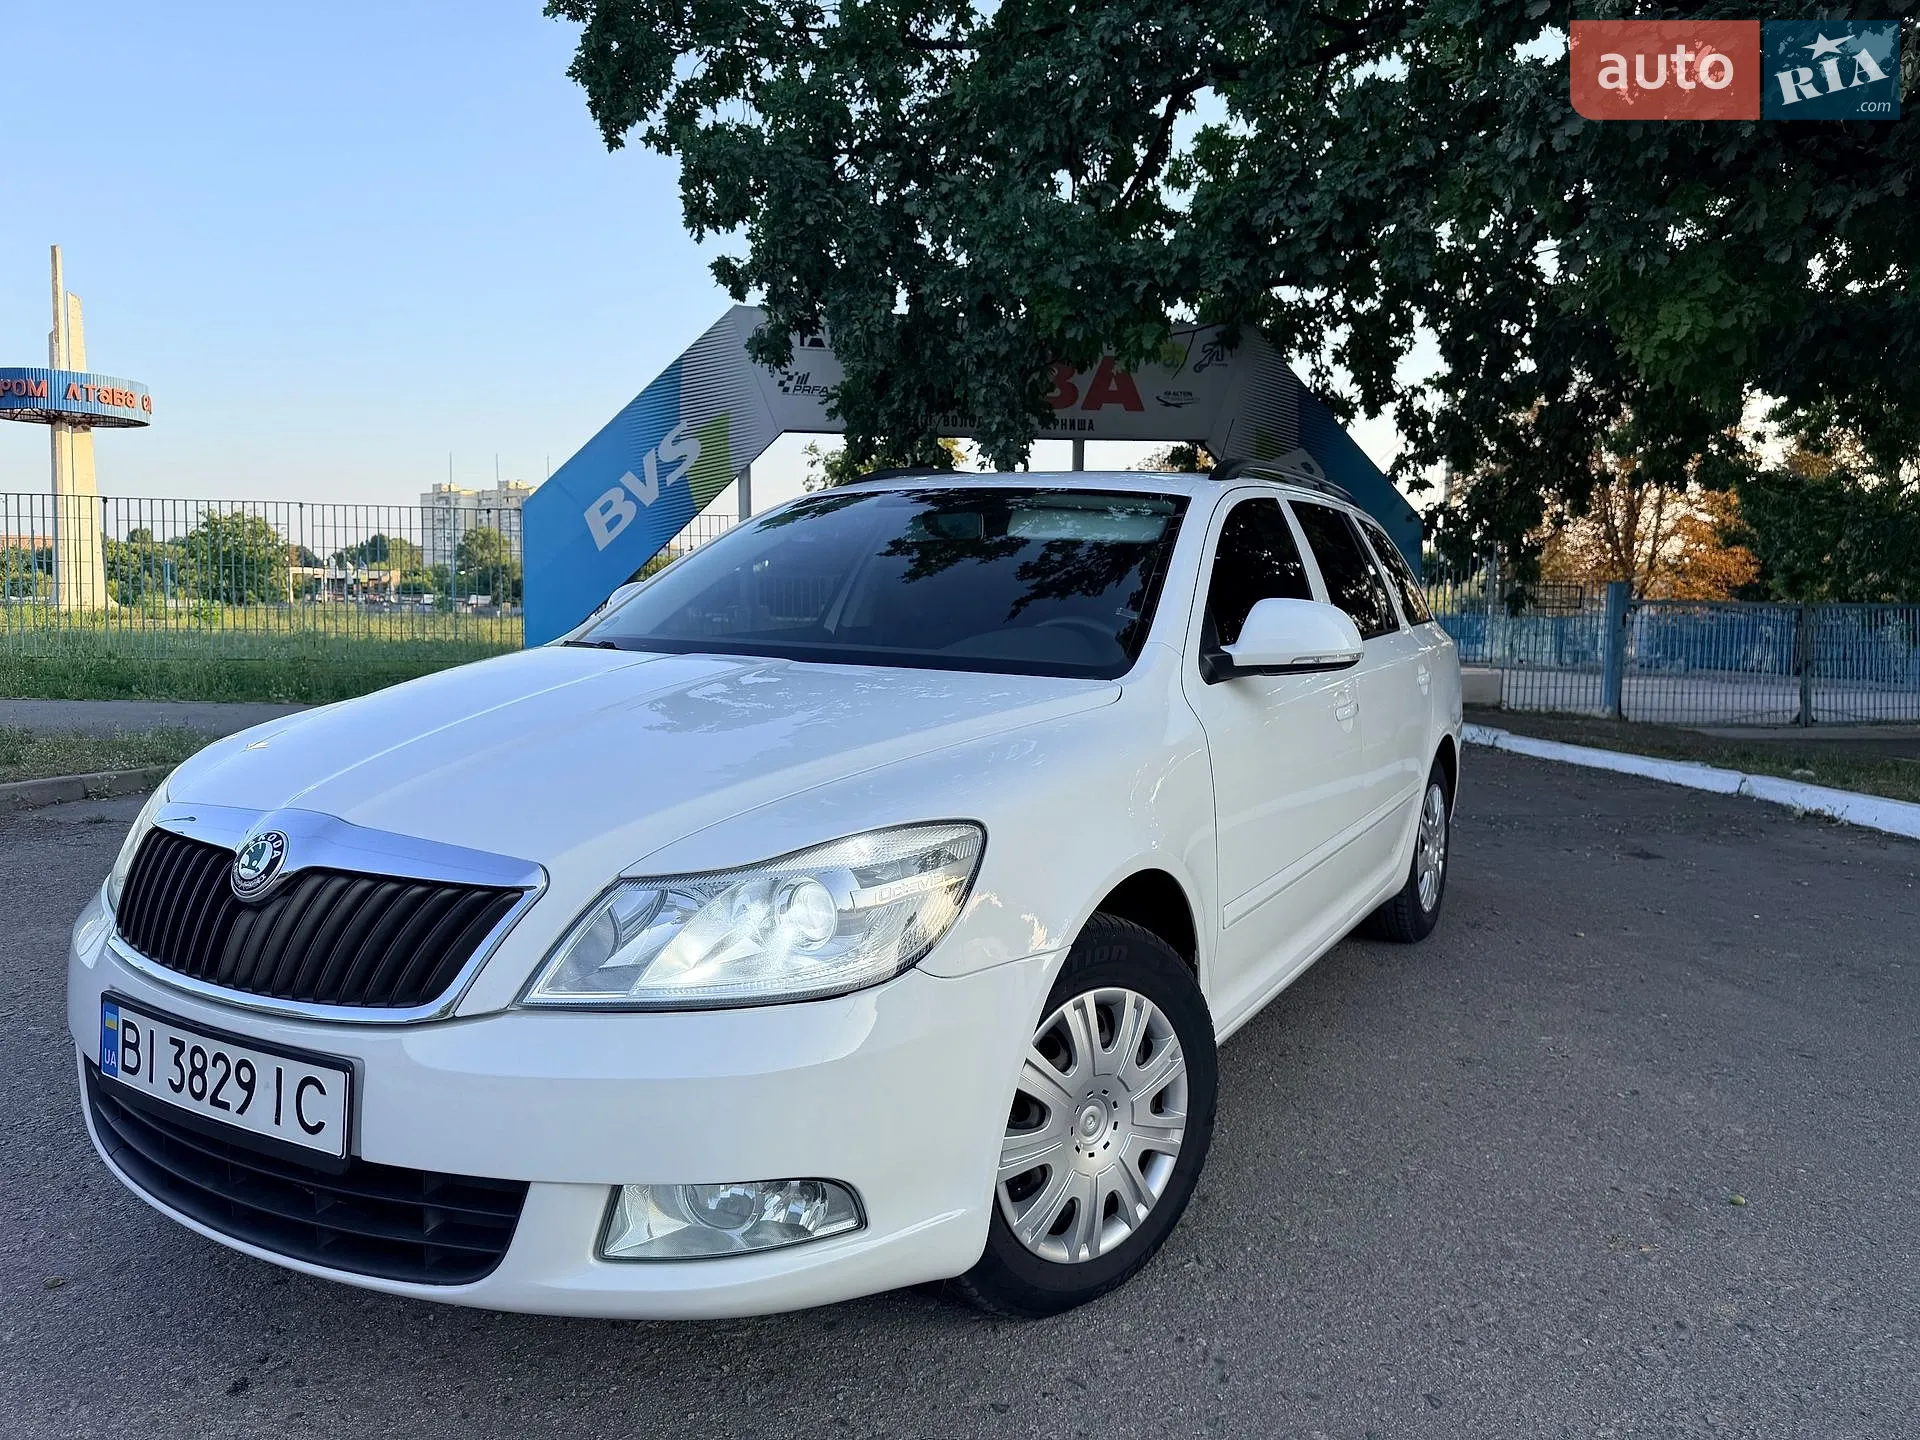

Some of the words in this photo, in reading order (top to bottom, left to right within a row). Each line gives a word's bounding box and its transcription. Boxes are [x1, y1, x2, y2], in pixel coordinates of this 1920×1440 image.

[1041, 418, 1094, 431] РНИША
[584, 420, 701, 552] BVS
[104, 1047, 117, 1067] UA
[120, 1018, 155, 1084] BI
[167, 1037, 257, 1116] 3829
[274, 1066, 328, 1136] IC
